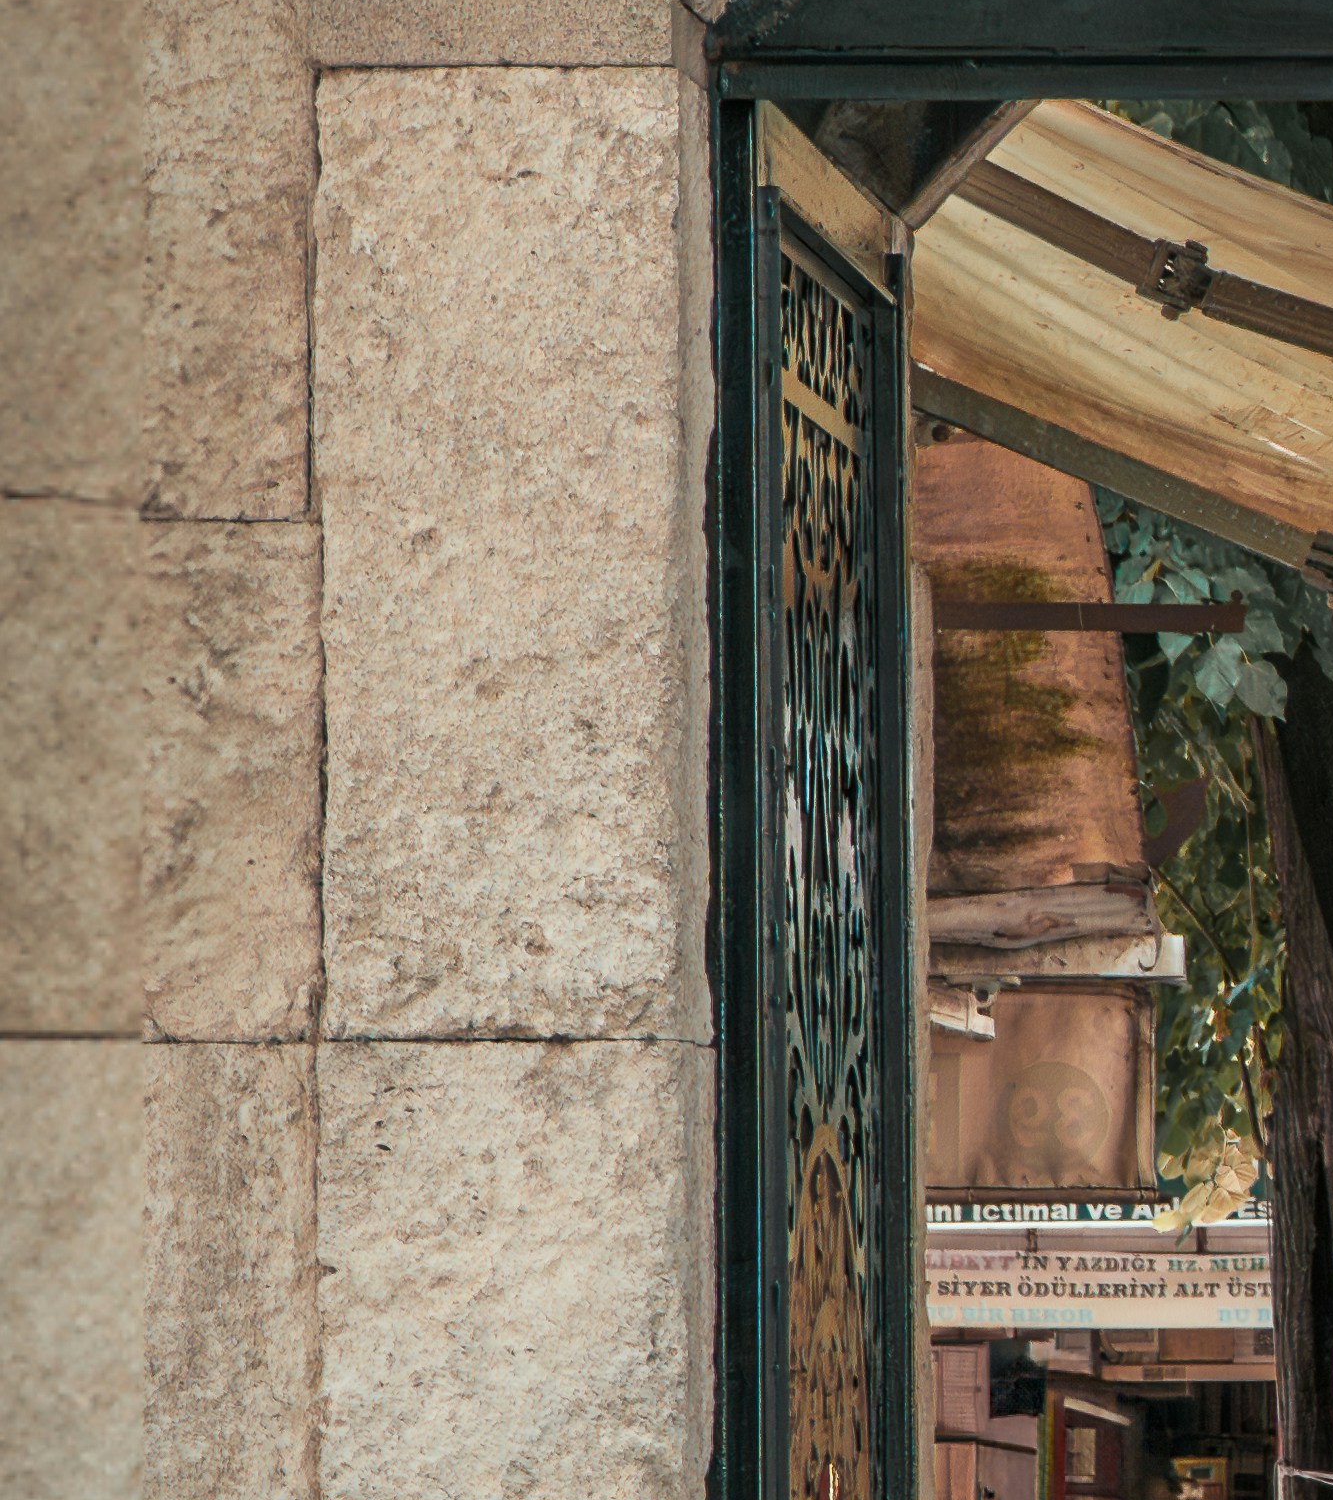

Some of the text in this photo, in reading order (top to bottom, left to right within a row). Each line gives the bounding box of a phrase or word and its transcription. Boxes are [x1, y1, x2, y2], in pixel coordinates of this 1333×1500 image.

[937, 1273, 1012, 1297] SİYER
[1017, 1274, 1167, 1299] ÖDÜLLERİNİ
[1173, 1282, 1221, 1298] ALT
